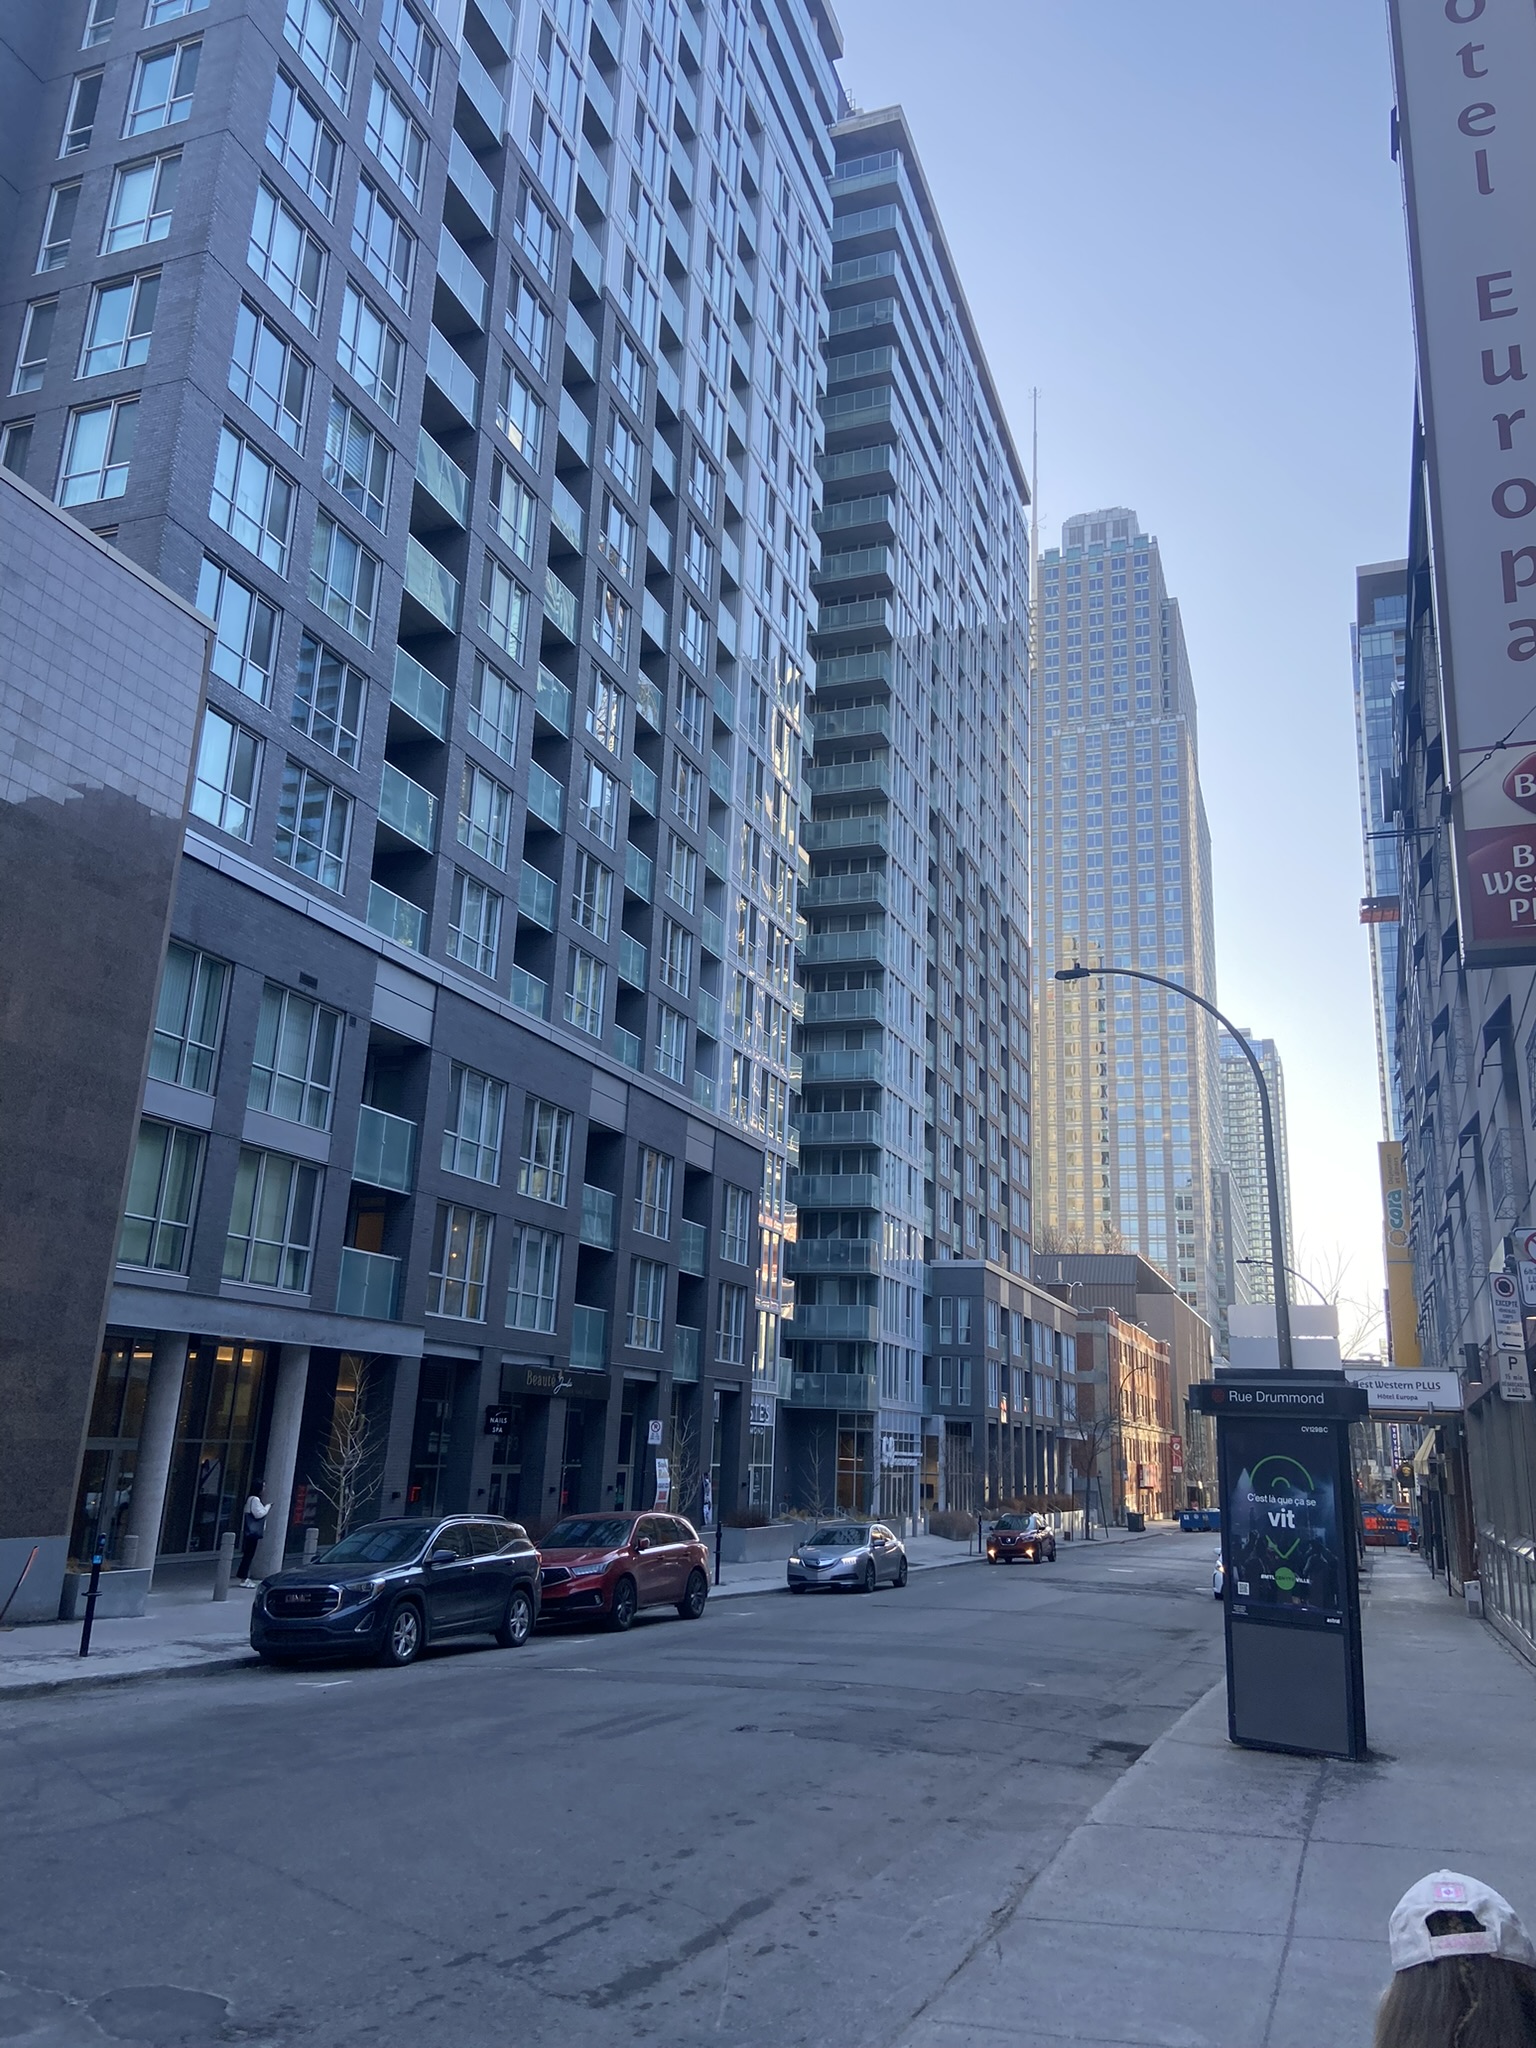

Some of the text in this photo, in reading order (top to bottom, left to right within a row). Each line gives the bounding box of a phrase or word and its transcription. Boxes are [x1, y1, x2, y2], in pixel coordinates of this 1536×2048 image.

[1388, 1189, 1403, 1229] cora
[1508, 1356, 1518, 1370] P
[1356, 1380, 1441, 1390] est Western PLUS
[1229, 1390, 1325, 1404] Rue Drummond
[1396, 1393, 1418, 1401] Europa
[1268, 1494, 1276, 1503] là
[1277, 1497, 1293, 1505] que
[1294, 1498, 1305, 1506] ça
[1267, 1508, 1296, 1529] vit
